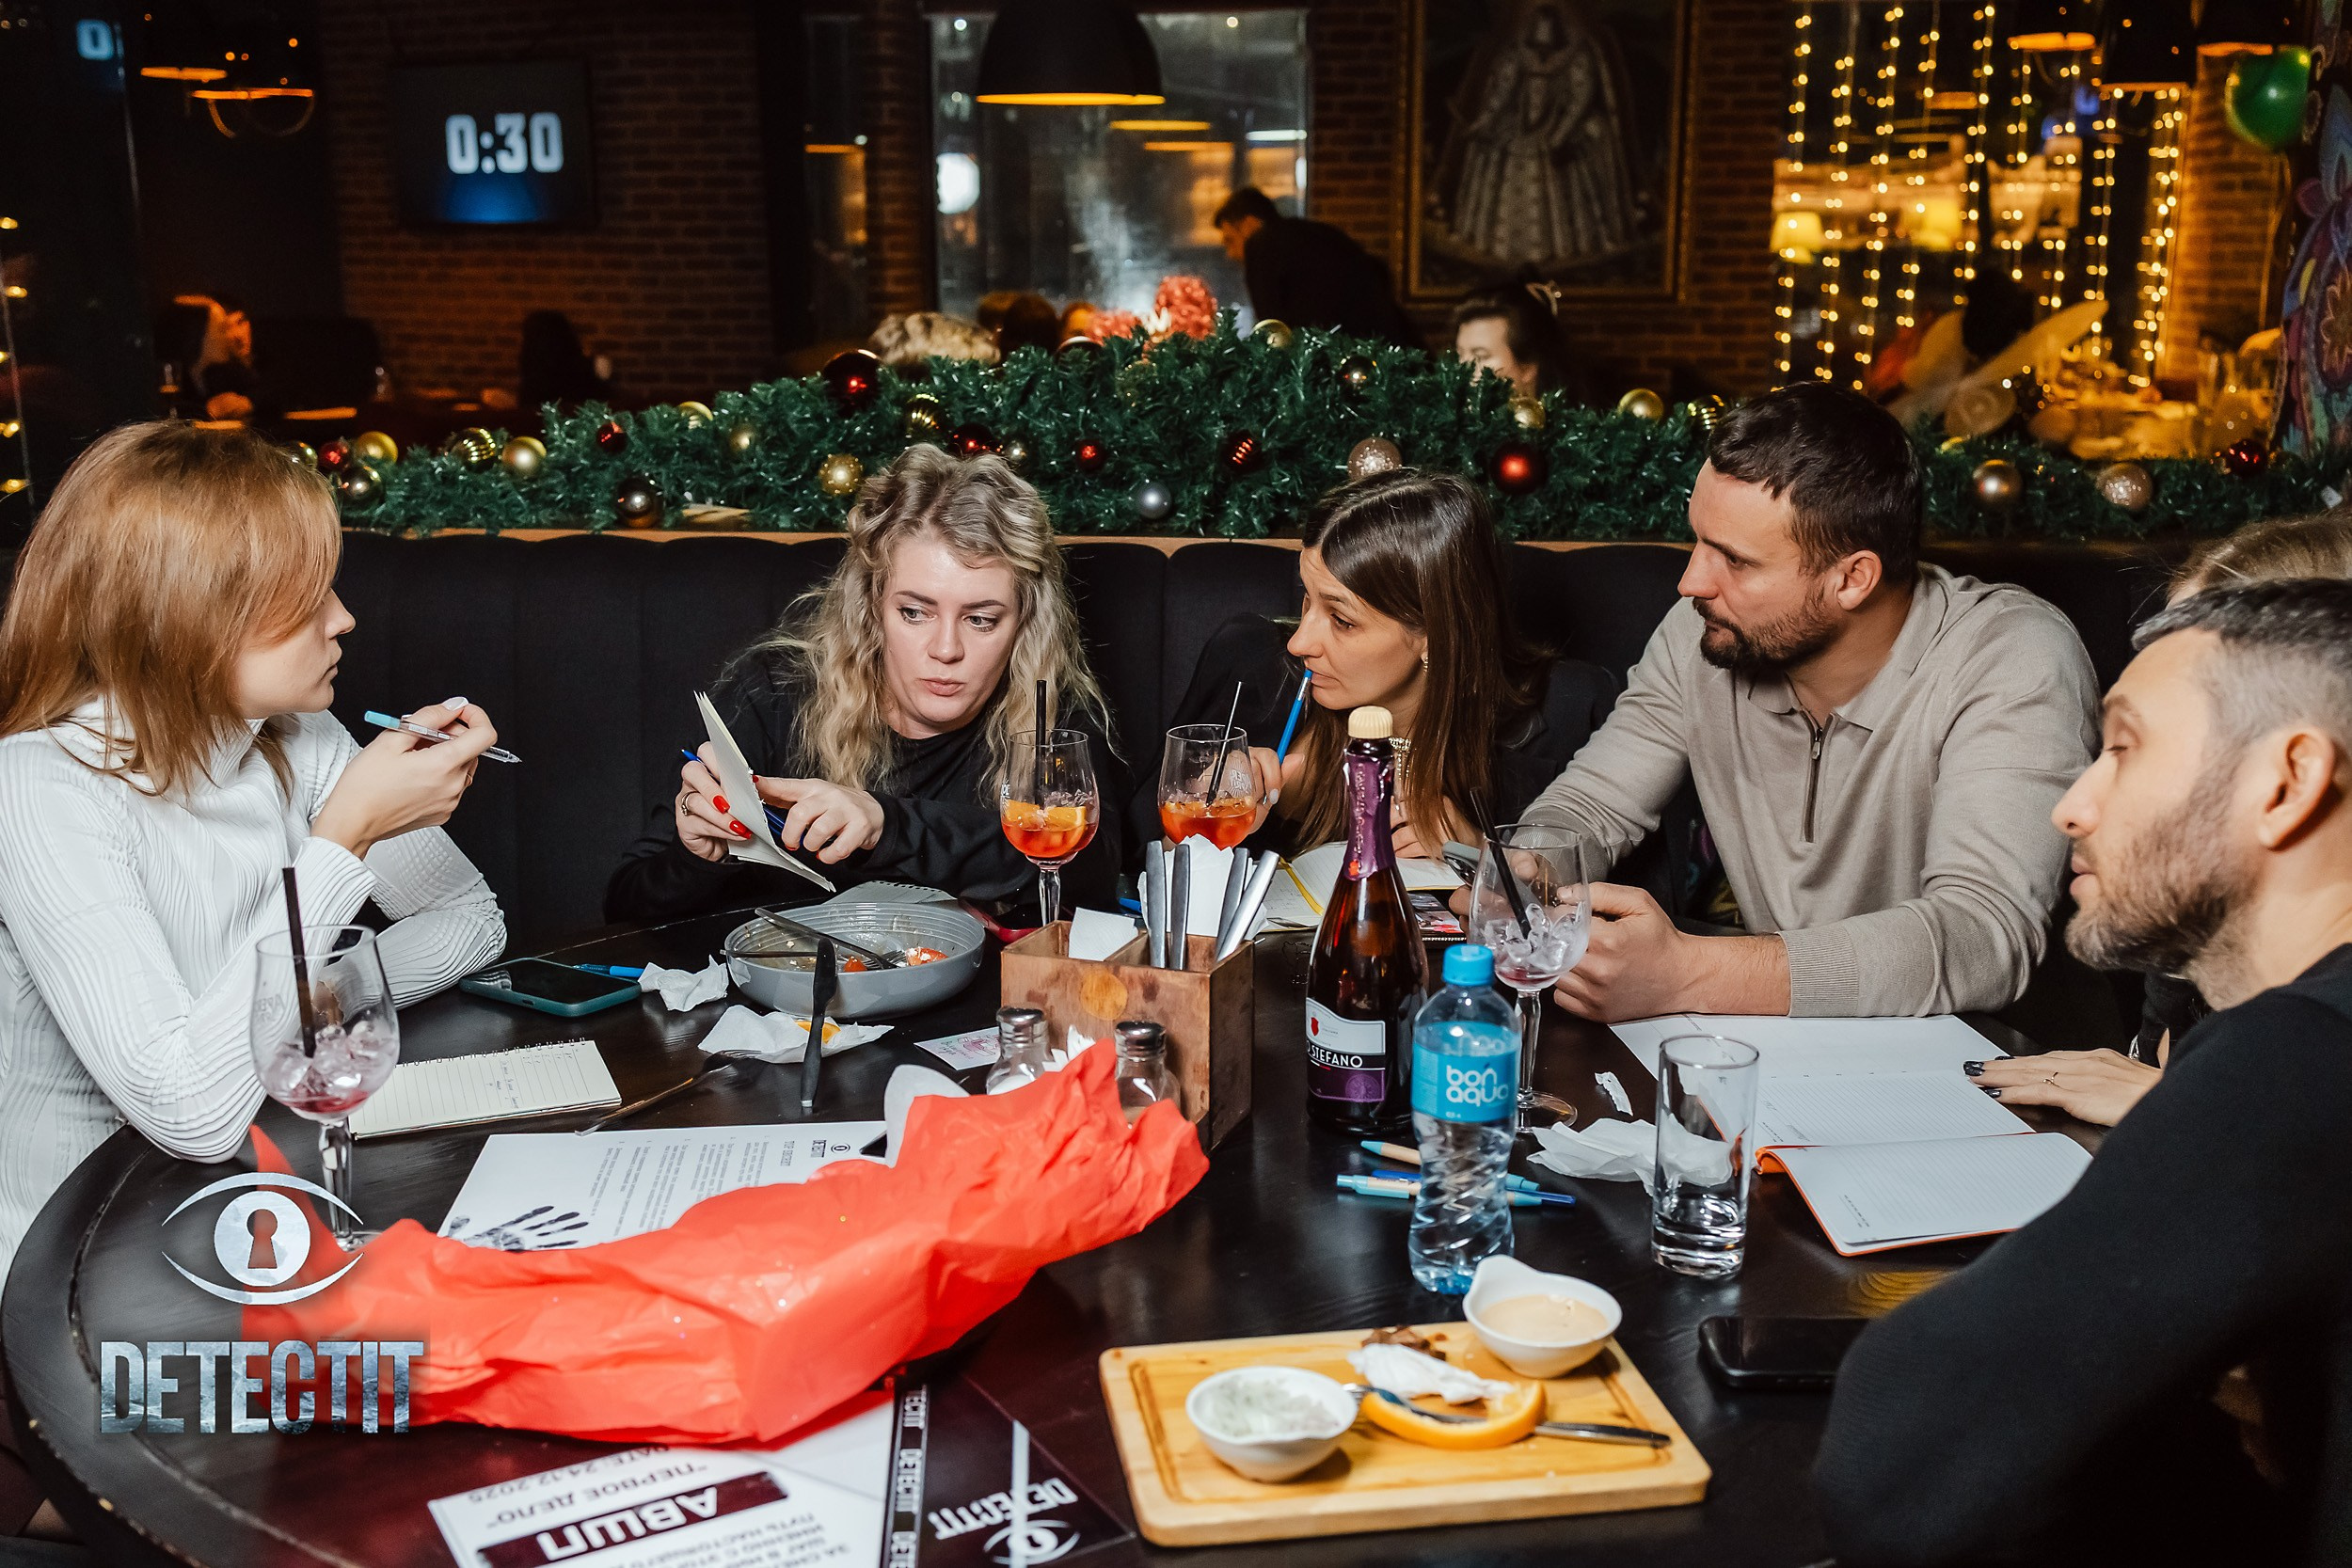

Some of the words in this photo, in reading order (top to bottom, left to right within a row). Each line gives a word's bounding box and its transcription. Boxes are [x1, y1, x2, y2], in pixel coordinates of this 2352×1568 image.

[445, 112, 564, 174] 0:30
[1311, 1045, 1363, 1069] STEFANO
[895, 1449, 923, 1514] DETECTIT
[928, 1477, 1079, 1540] DEECTIT
[536, 1486, 718, 1561] АВШП
